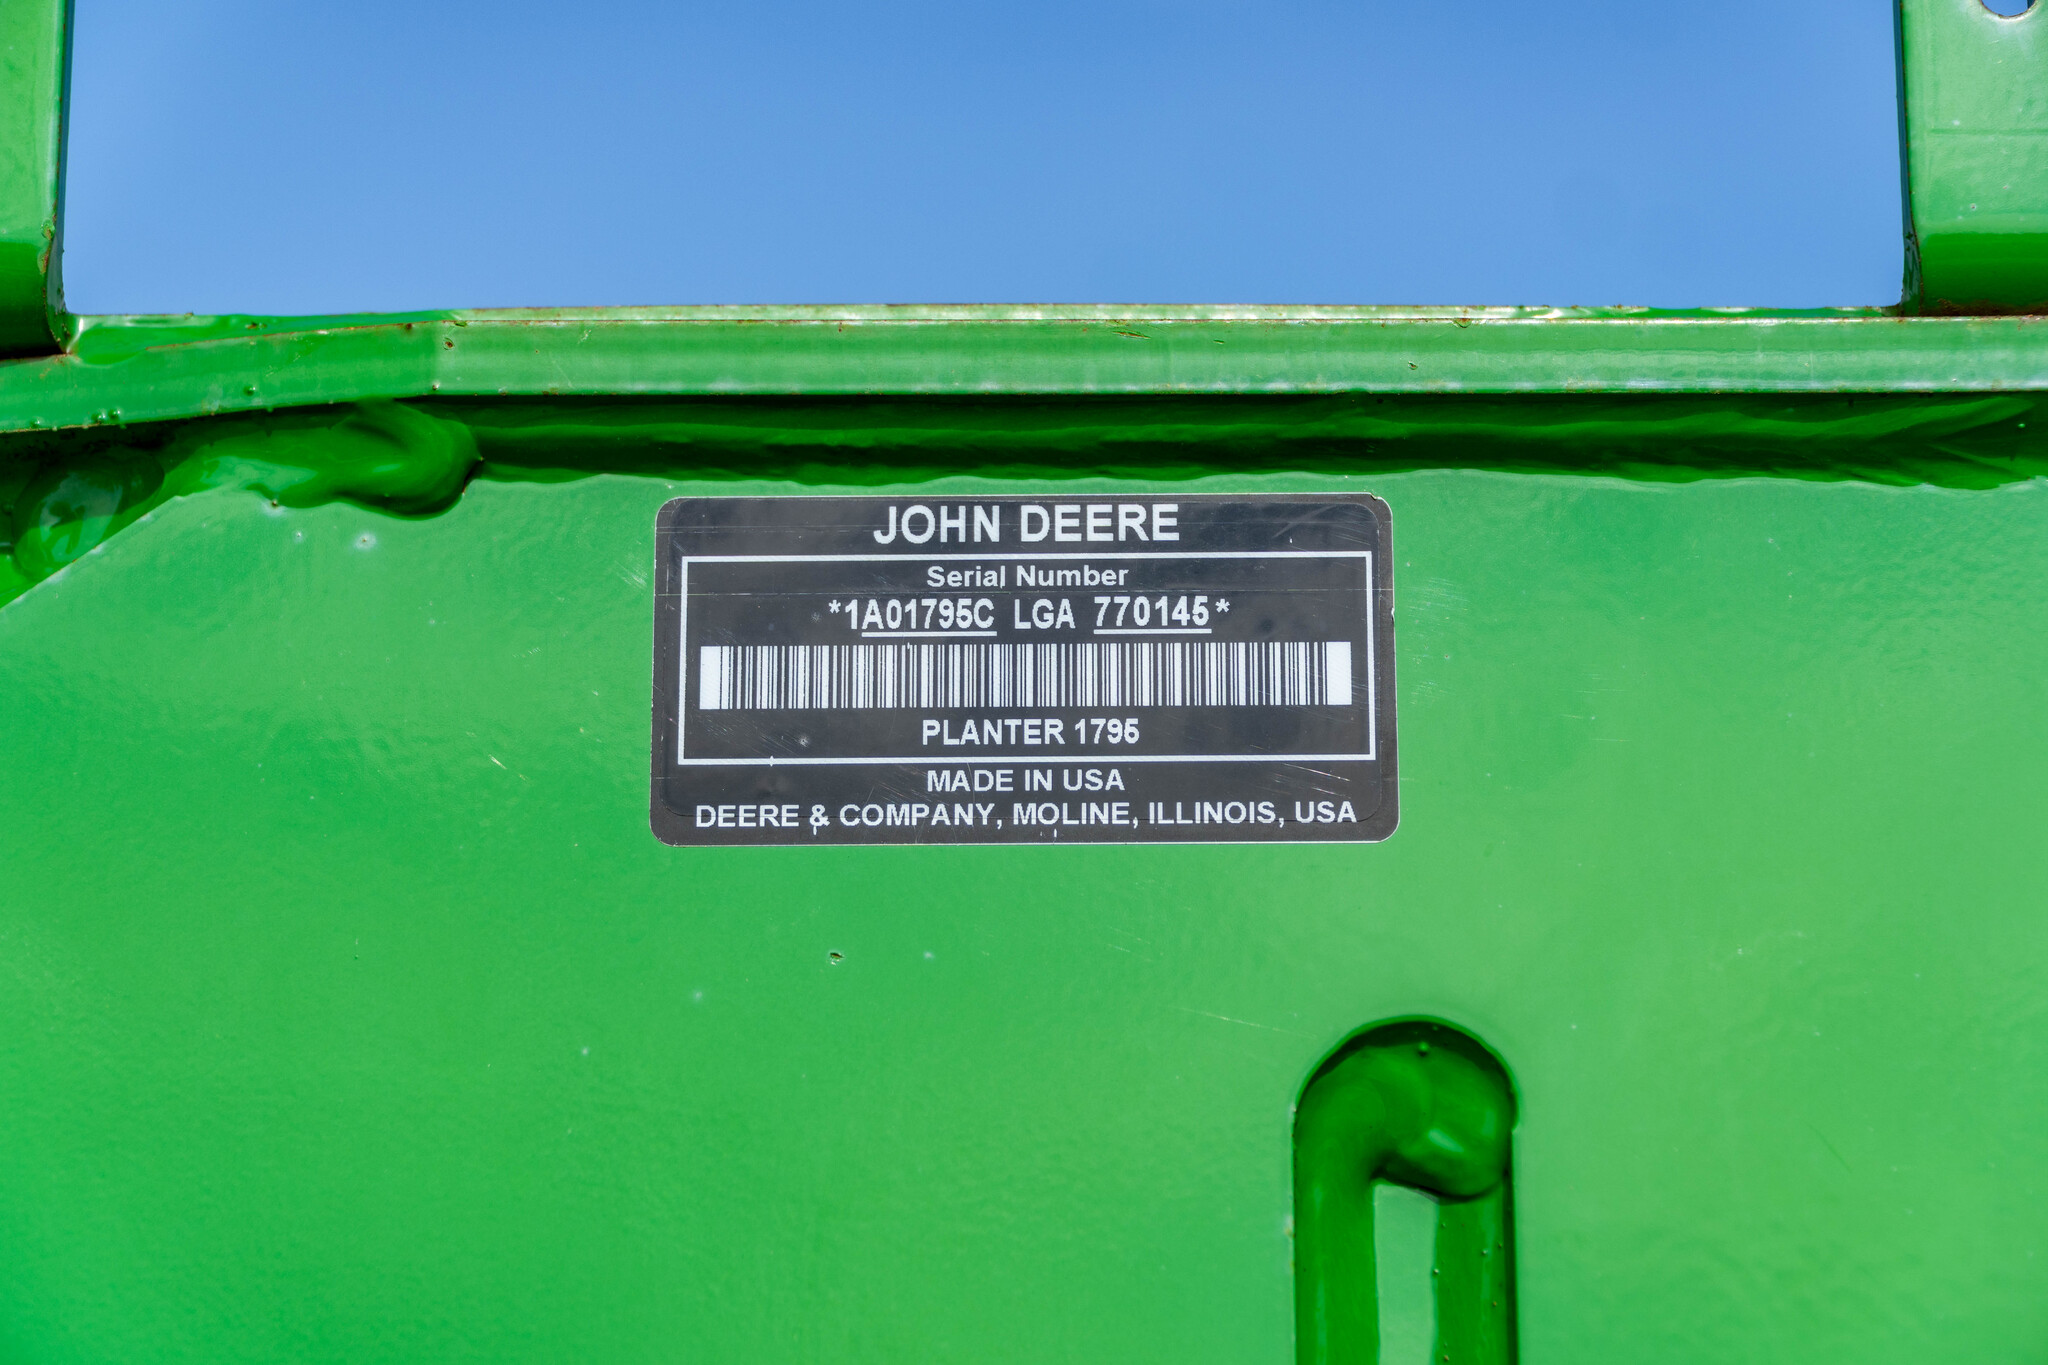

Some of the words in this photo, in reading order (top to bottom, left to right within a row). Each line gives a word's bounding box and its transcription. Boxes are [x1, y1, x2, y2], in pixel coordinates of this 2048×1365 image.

[874, 505, 1000, 543] JOHN
[1020, 504, 1180, 542] DEERE
[926, 565, 1006, 588] Serial
[1016, 565, 1129, 587] Number
[1014, 599, 1076, 630] LGA
[922, 718, 1066, 746] PLANTER
[927, 769, 1014, 792] MADE
[1024, 769, 1053, 792] IN
[1063, 768, 1126, 791] USA
[695, 804, 799, 828] DEERE
[810, 804, 831, 828] &
[839, 803, 1003, 830] COMPANY,
[1012, 802, 1139, 829] MOLINE,
[1149, 801, 1285, 829] ILLINOIS,
[1295, 800, 1357, 824] USA
